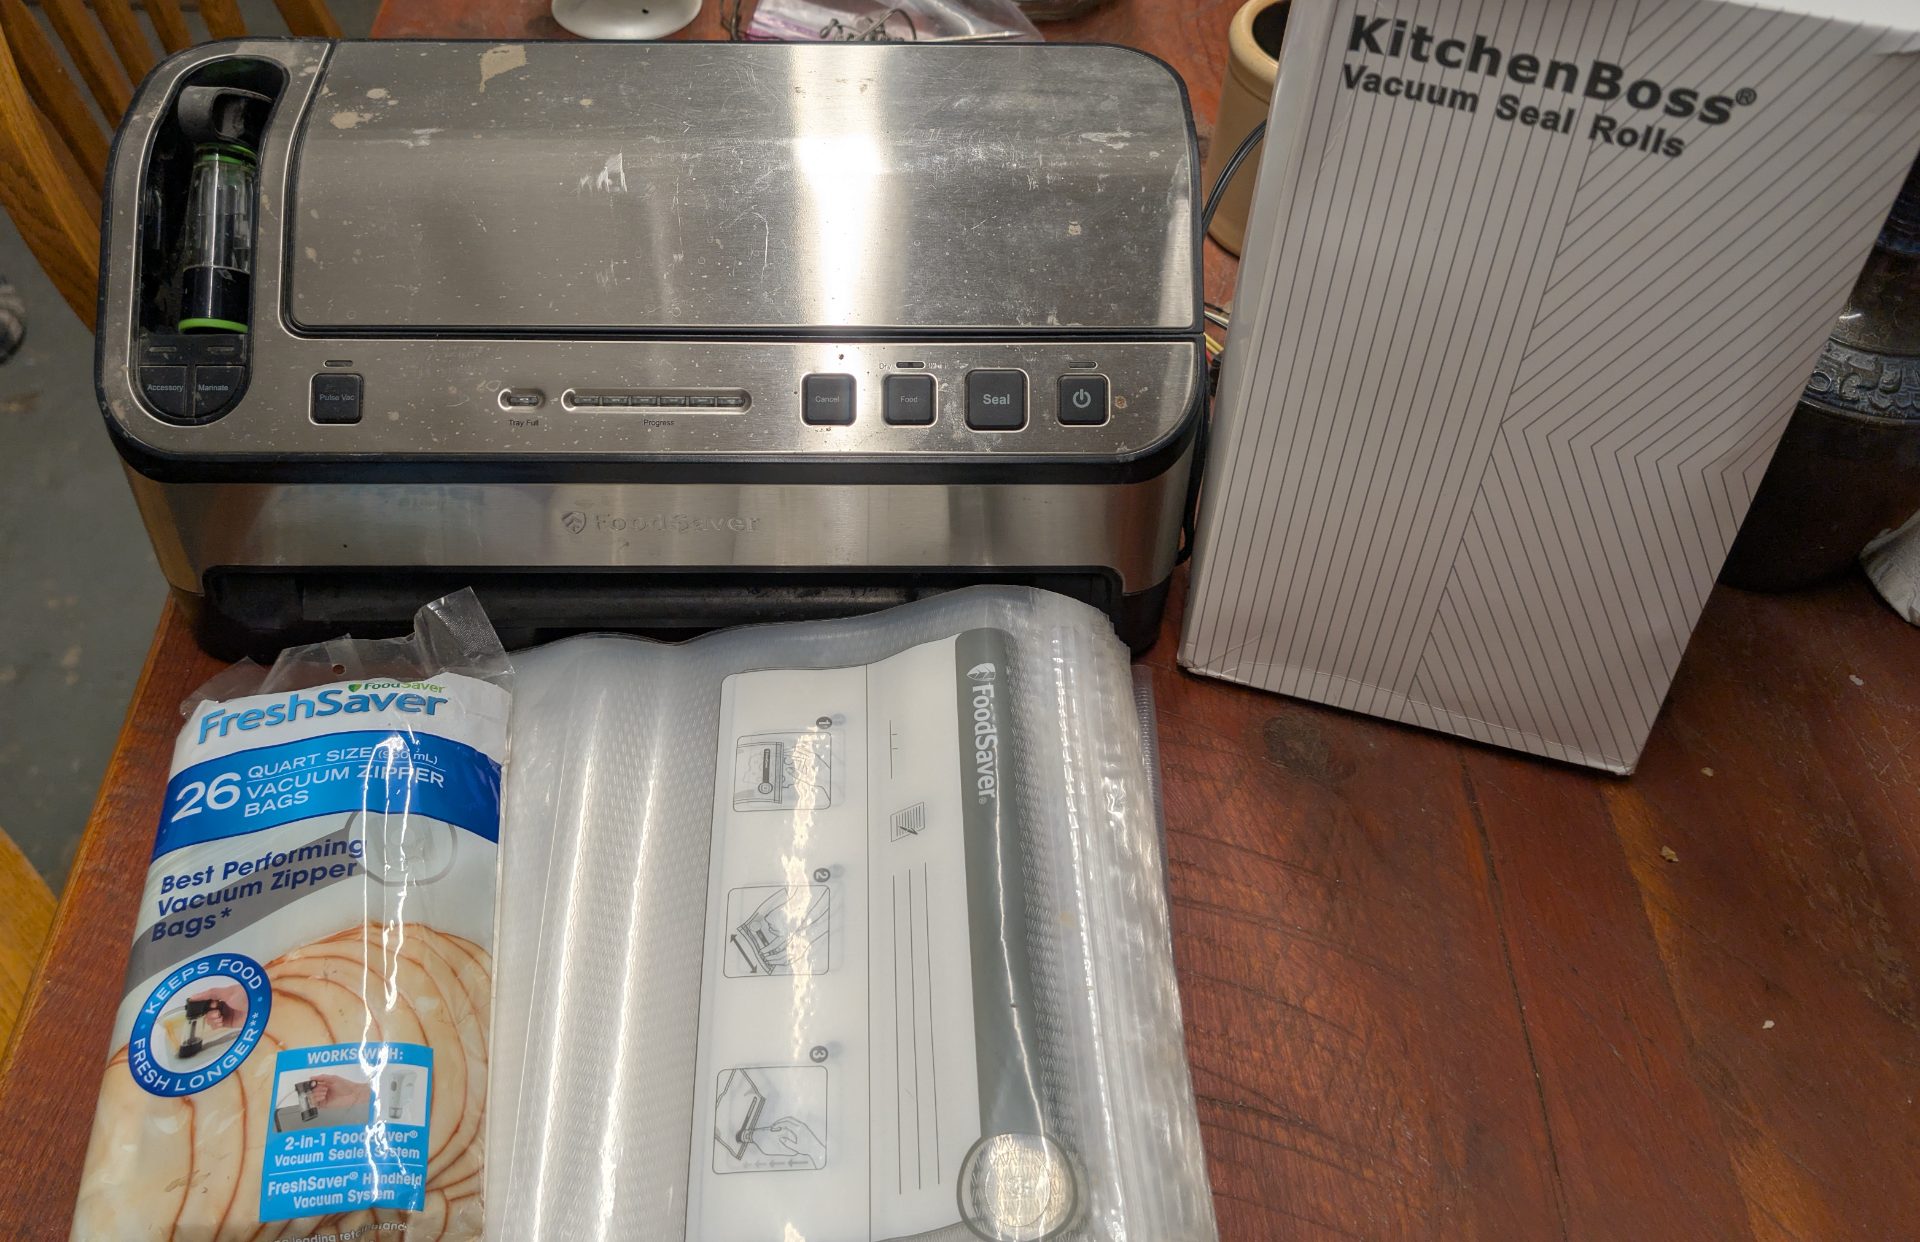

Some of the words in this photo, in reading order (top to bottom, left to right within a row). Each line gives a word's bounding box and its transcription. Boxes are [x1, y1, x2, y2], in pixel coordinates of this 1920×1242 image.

[1343, 63, 1479, 114] Vacuum
[1495, 93, 1575, 135] Seal
[1588, 113, 1686, 159] Rolls
[147, 383, 184, 393] Accessory
[198, 383, 229, 392] Marinate
[319, 393, 340, 401] Pulse
[341, 393, 355, 401] Vac
[815, 395, 840, 403] Cancel
[900, 395, 918, 403] Food
[982, 393, 1010, 405] Seal
[508, 419, 525, 428] Tray
[643, 419, 675, 428] Progress
[594, 513, 760, 533] FoodSaver
[197, 689, 448, 745] FreshSaver
[247, 752, 316, 779] QUART
[326, 746, 373, 763] SIZE
[247, 767, 349, 800] VACUUM
[357, 764, 445, 789] ZIPPER
[171, 772, 241, 823] 26
[244, 790, 309, 818] BAGS
[160, 865, 214, 895] Best
[222, 838, 367, 881] Performing
[158, 879, 262, 917] Vacuum
[270, 862, 357, 891] Zipper
[145, 961, 210, 1015] KEEPS
[217, 959, 262, 990] FOOD
[134, 1037, 171, 1091] FRESH
[307, 1048, 359, 1065] WORKS
[363, 1047, 404, 1061] WH:
[284, 1132, 326, 1151] 2-in-1
[274, 1154, 324, 1167] Vacuum
[362, 1172, 422, 1187] Hndheld
[293, 1194, 343, 1209] Vacuum
[347, 1189, 395, 1204] Sysem
